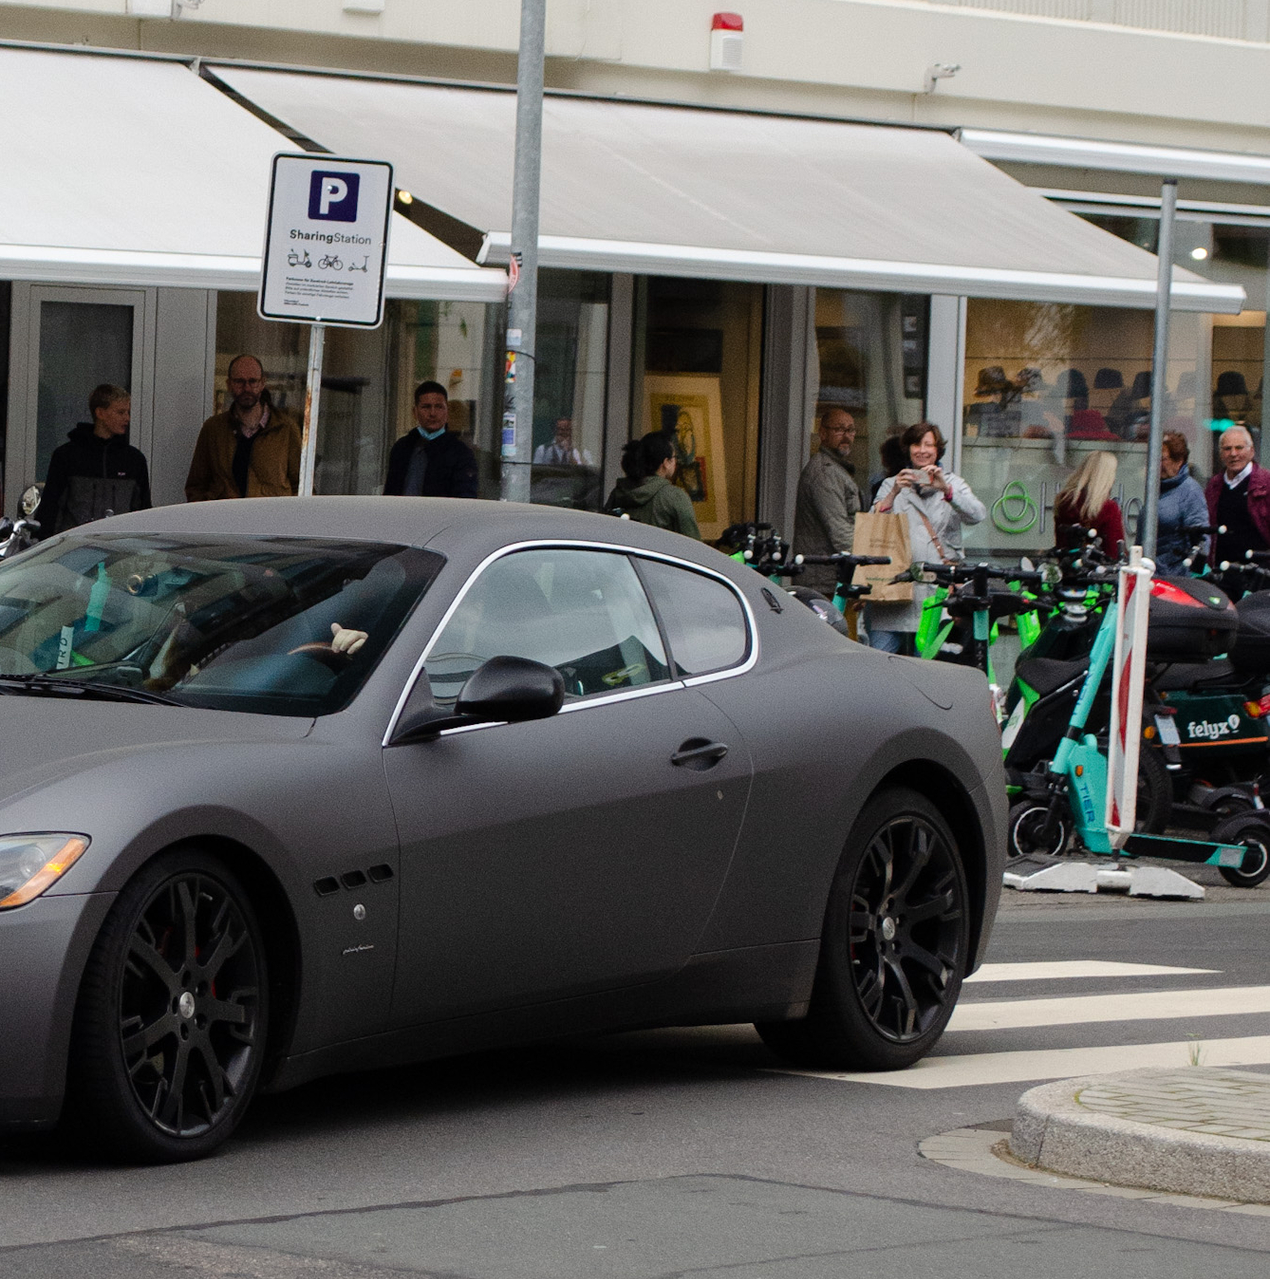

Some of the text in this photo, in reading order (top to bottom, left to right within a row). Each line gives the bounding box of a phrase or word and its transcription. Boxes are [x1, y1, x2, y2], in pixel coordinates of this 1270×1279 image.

[319, 177, 348, 215] P
[289, 229, 372, 245] SharingStation
[1187, 719, 1230, 740] felyx
[1081, 782, 1095, 824] TIER
